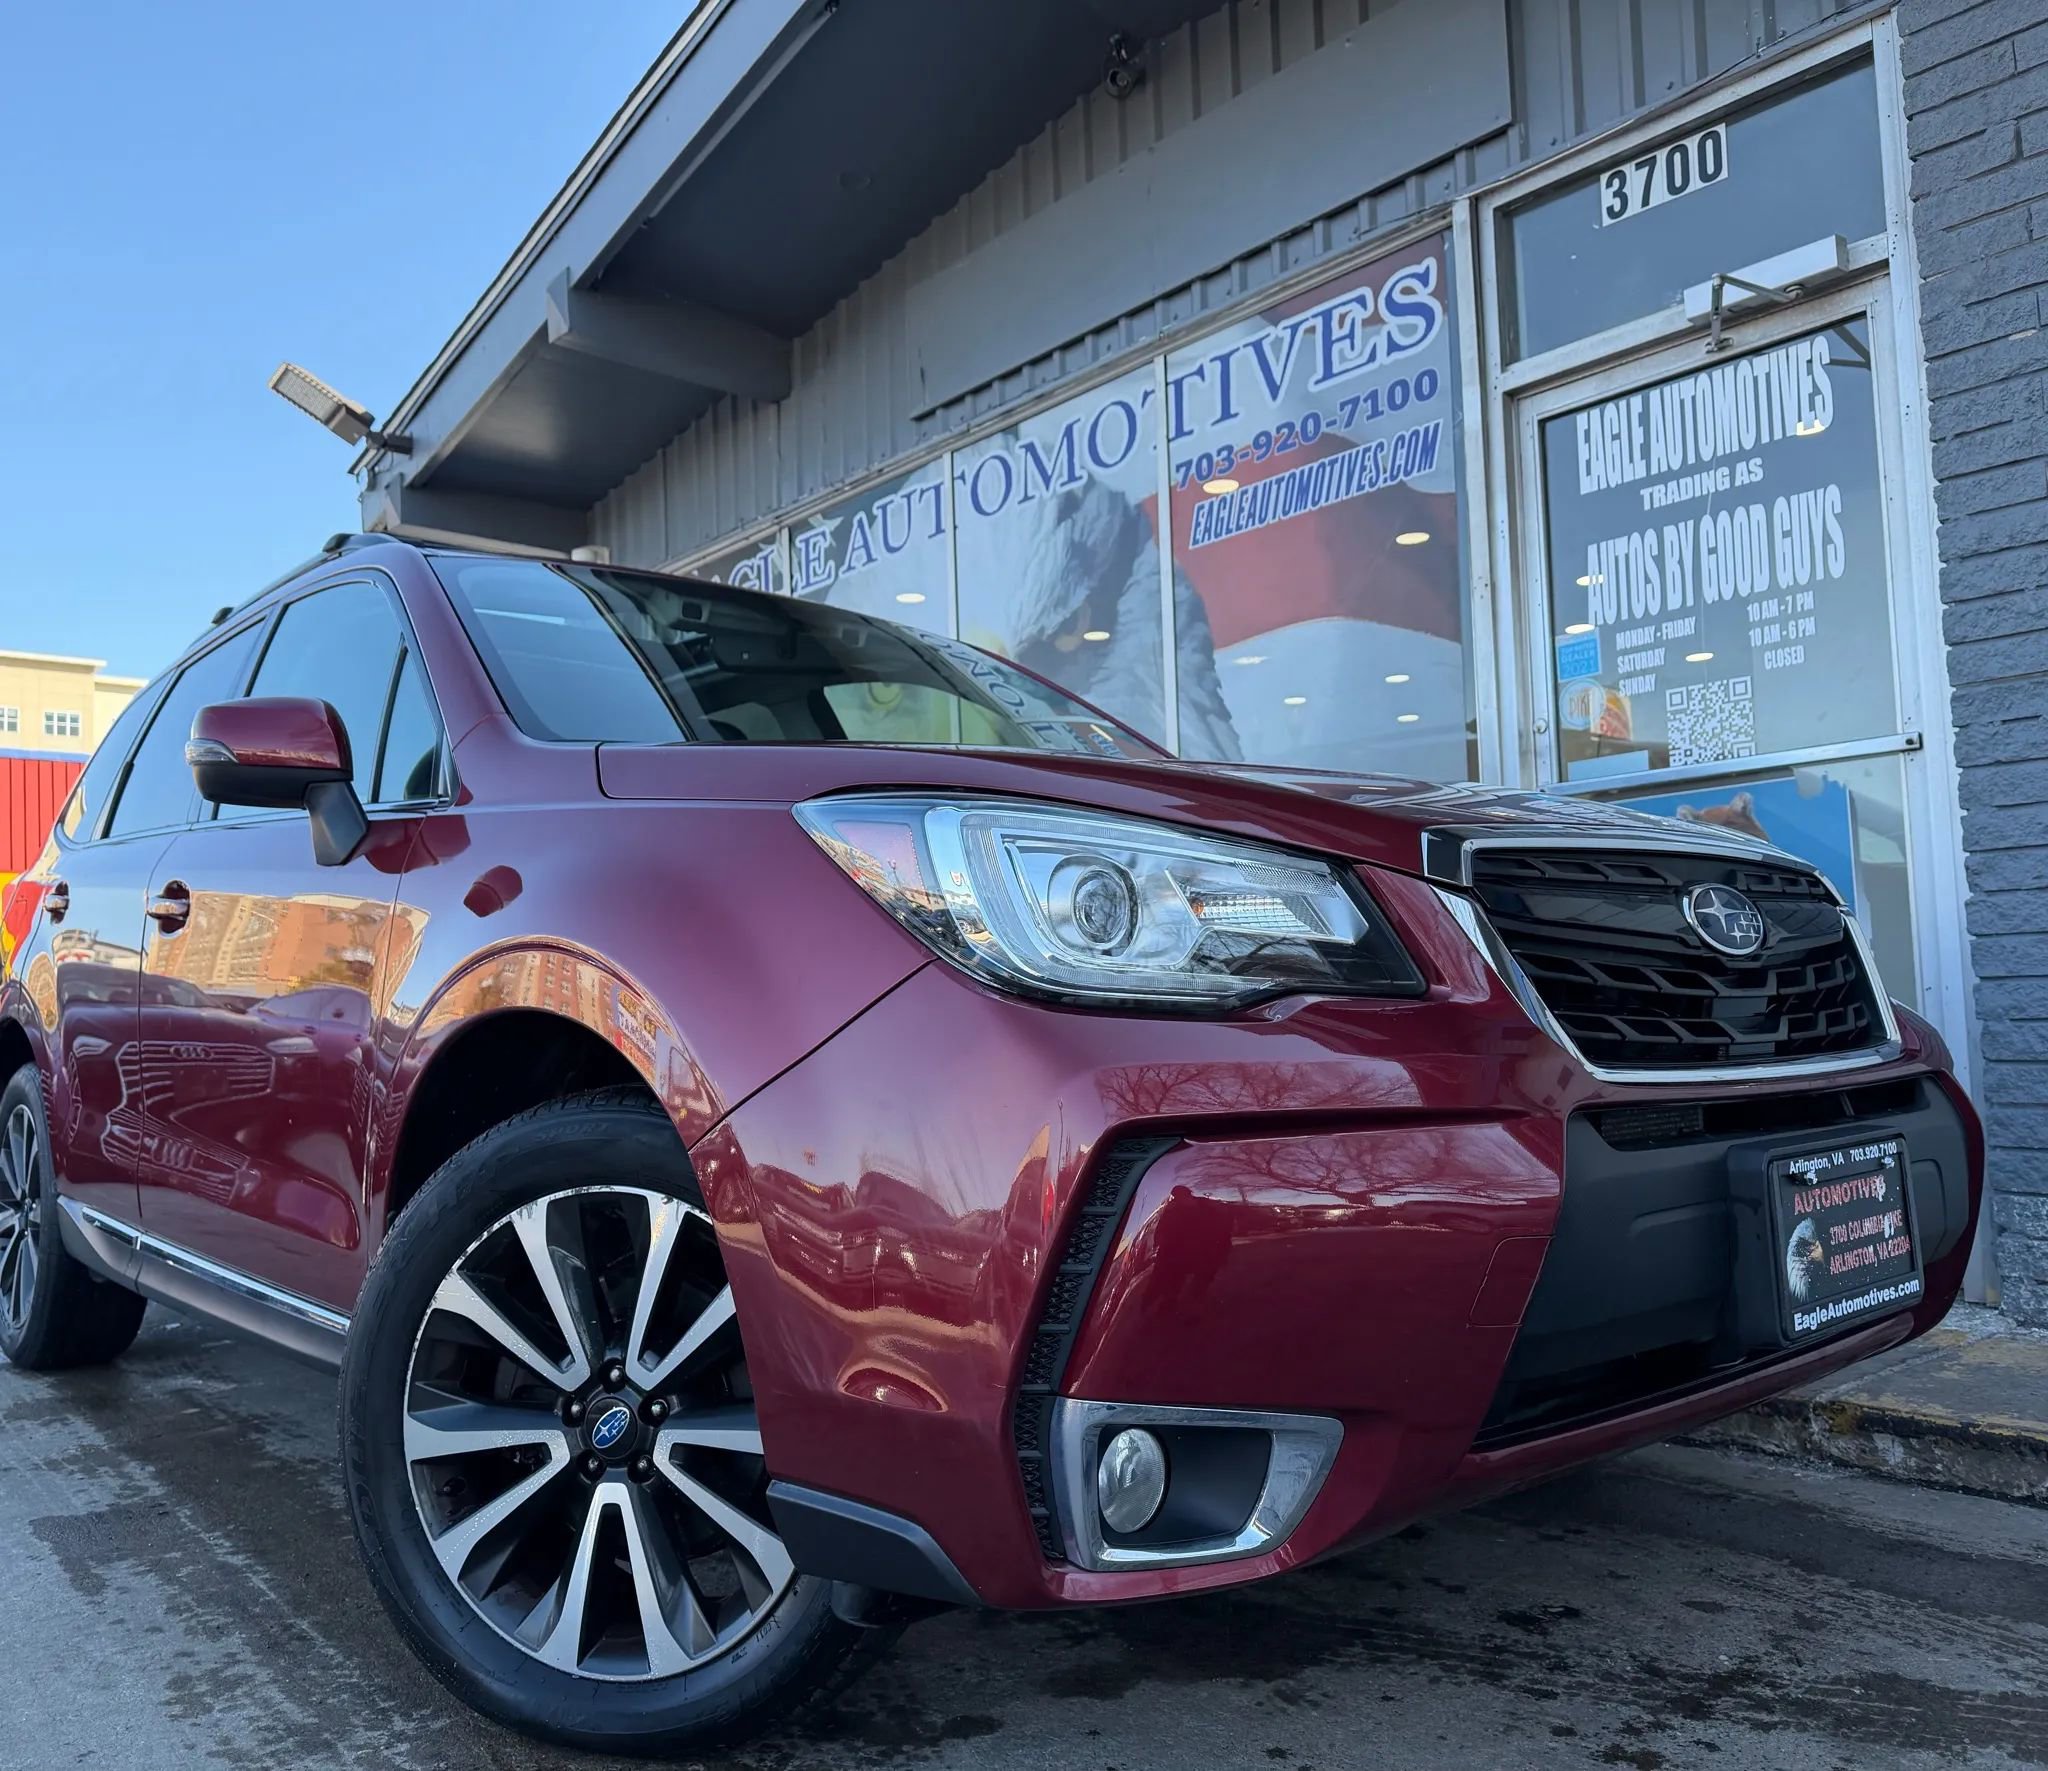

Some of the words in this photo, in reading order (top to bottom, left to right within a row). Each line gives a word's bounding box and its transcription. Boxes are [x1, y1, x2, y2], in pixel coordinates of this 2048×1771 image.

[1605, 130, 1723, 220] 3700
[691, 526, 836, 597] GLE
[837, 257, 1443, 578] AUTOMOTIVES
[1175, 367, 1440, 491] 703-920-7100
[1576, 394, 1647, 496] EAGLE
[1650, 336, 1834, 476] AUTOMOTIVES
[1189, 419, 1443, 549] EAGLEAUTOMOTIVES.COM
[1640, 467, 1730, 511] TRADING
[1734, 457, 1764, 487] AS
[1587, 527, 1661, 626] AUTOS
[1663, 519, 1697, 612] BY
[1700, 503, 1772, 606] GOOD
[1773, 484, 1846, 590] GUYS
[1785, 594, 1793, 614] 7
[1796, 590, 1814, 612] PM
[1616, 625, 1656, 650] MONDAY
[1662, 616, 1696, 640] FRIDAY
[1788, 620, 1797, 640] 6
[1797, 616, 1816, 638] PM
[1563, 660, 1596, 678] 2021
[1617, 647, 1666, 674] SATURDAY
[1764, 645, 1805, 670] CLOSED
[1619, 673, 1656, 697] SUNDAY
[1789, 1155, 1831, 1175] Arlington,
[1832, 1152, 1845, 1165] VA
[1850, 1142, 1897, 1162] 703.920.7100
[1830, 1224, 1848, 1245] 3700
[1830, 1245, 1877, 1275] ARLINGTON,
[1877, 1242, 1890, 1260] VA
[1794, 1278, 1920, 1331] EagleAutomotives.com
